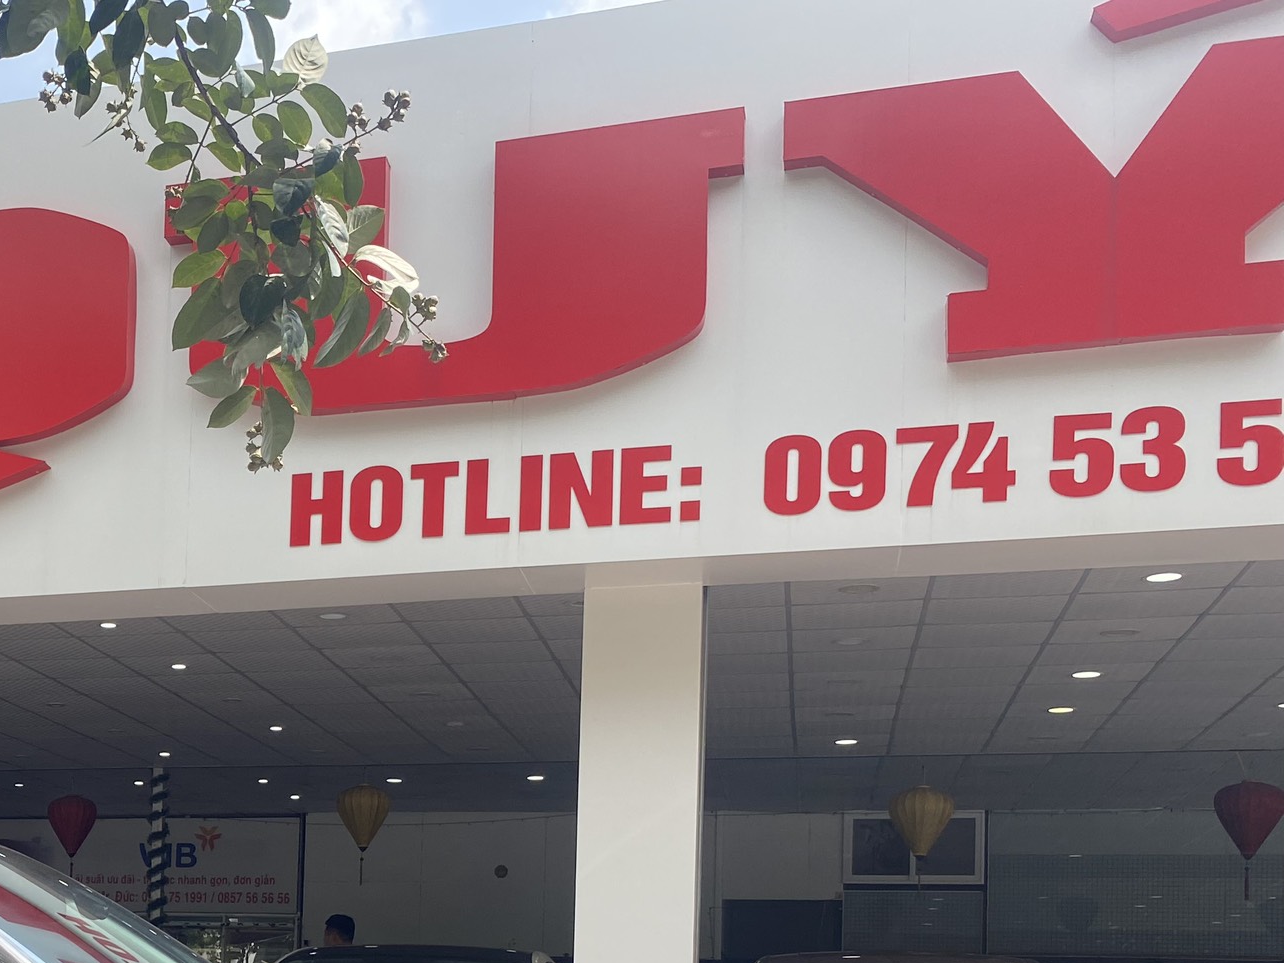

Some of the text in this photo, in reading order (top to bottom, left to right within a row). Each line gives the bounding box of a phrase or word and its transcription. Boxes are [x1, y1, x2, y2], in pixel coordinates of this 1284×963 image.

[290, 446, 702, 547] HOTLINE:
[763, 412, 1016, 516] 0974
[1049, 406, 1187, 498] 53
[177, 875, 207, 885] nhanh
[233, 875, 254, 885] đơn
[184, 891, 208, 903] 1991
[217, 891, 243, 904] 0857
[245, 891, 259, 904] 56
[261, 891, 275, 904] 56
[276, 891, 291, 904] 56
